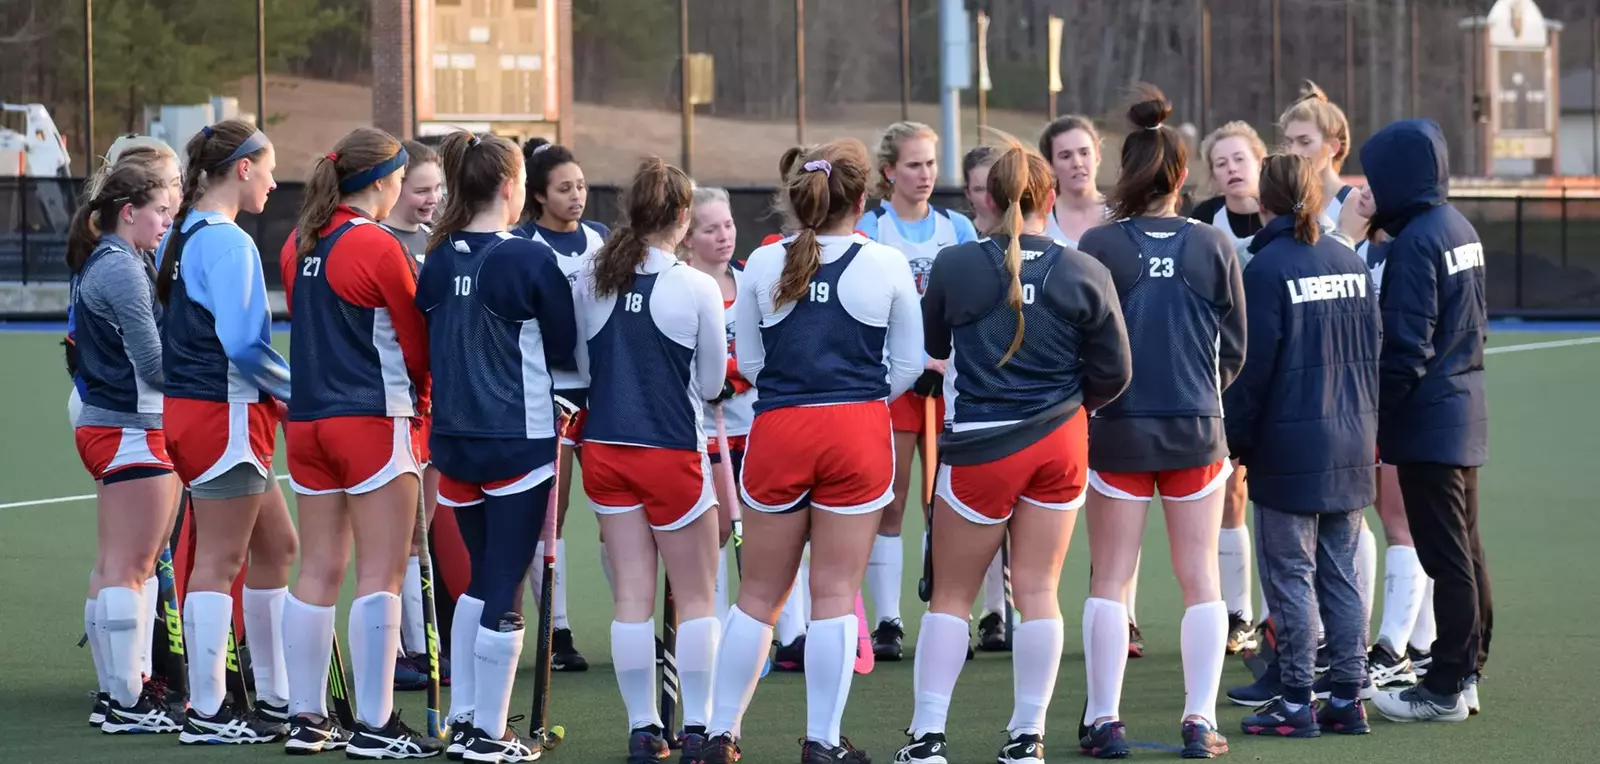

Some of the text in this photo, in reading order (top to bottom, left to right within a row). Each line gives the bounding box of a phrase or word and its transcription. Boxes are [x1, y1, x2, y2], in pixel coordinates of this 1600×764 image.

[303, 256, 321, 277] 27
[1149, 257, 1175, 278] 23
[454, 275, 472, 296] 10
[809, 281, 830, 303] 19
[1286, 273, 1366, 304] LIBERTY
[624, 292, 644, 313] 18
[164, 600, 185, 656] JDH
